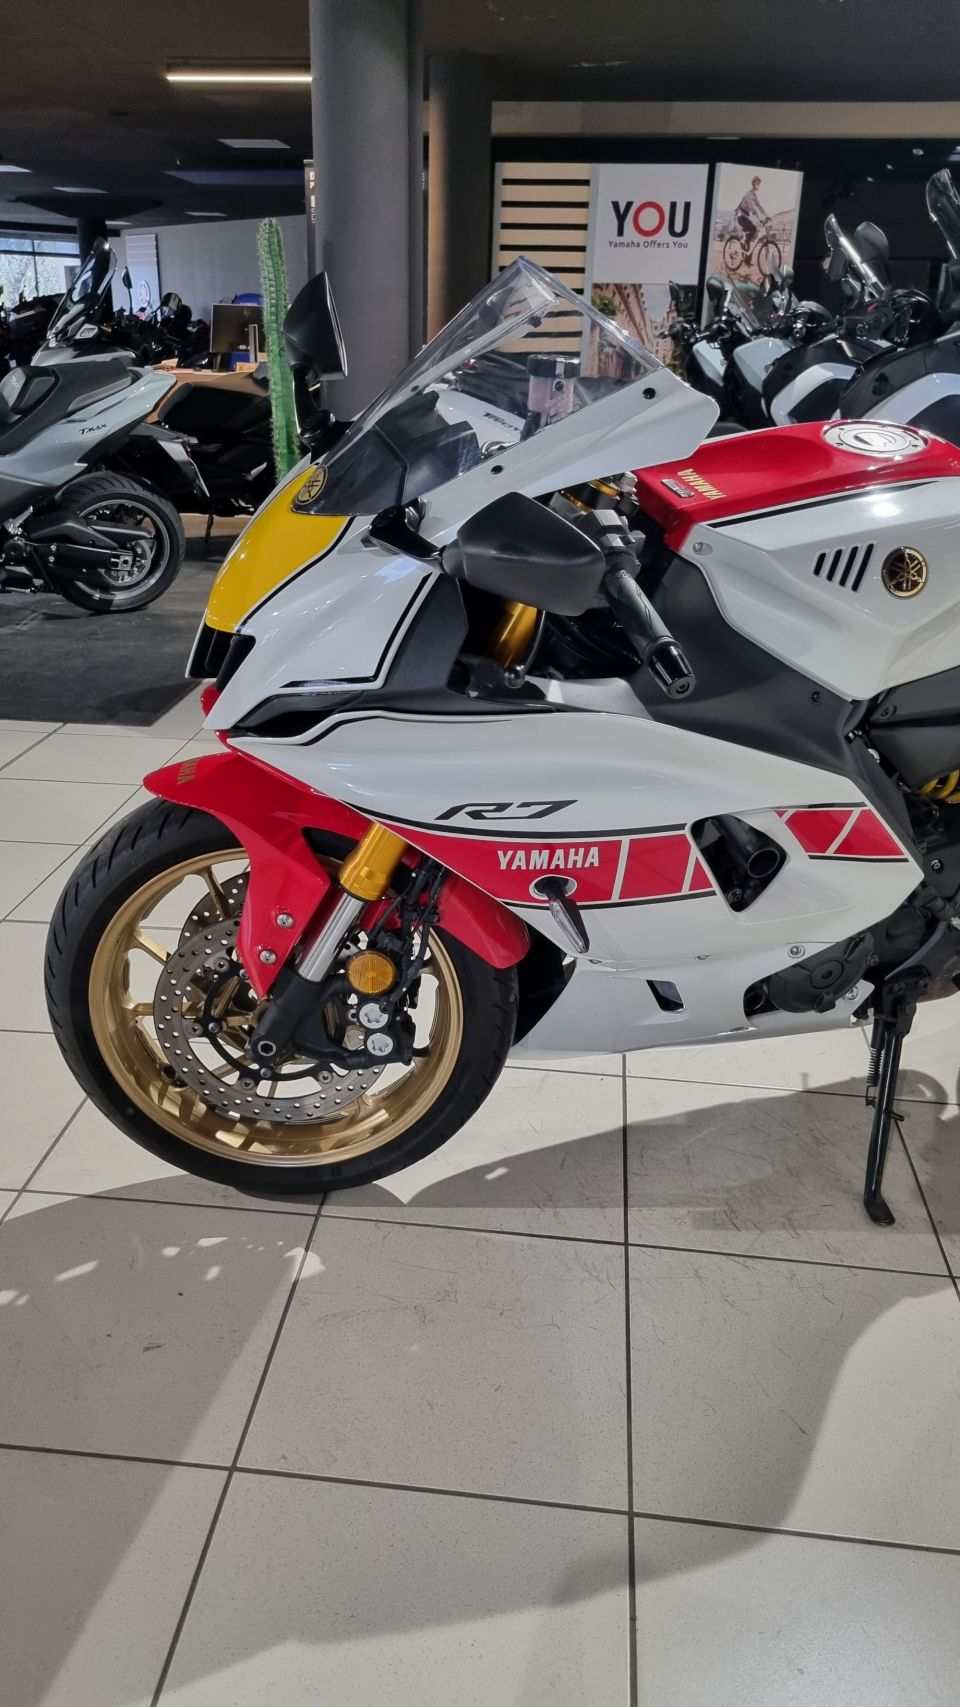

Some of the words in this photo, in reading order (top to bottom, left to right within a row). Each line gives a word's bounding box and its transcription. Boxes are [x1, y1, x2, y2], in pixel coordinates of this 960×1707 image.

[611, 200, 692, 238] YOU
[608, 240, 641, 249] Yamaha
[643, 240, 670, 249] Offers
[672, 240, 689, 249] You
[677, 468, 727, 500] YAMAHA
[434, 799, 578, 820] R7
[497, 846, 600, 870] YAMAHA
